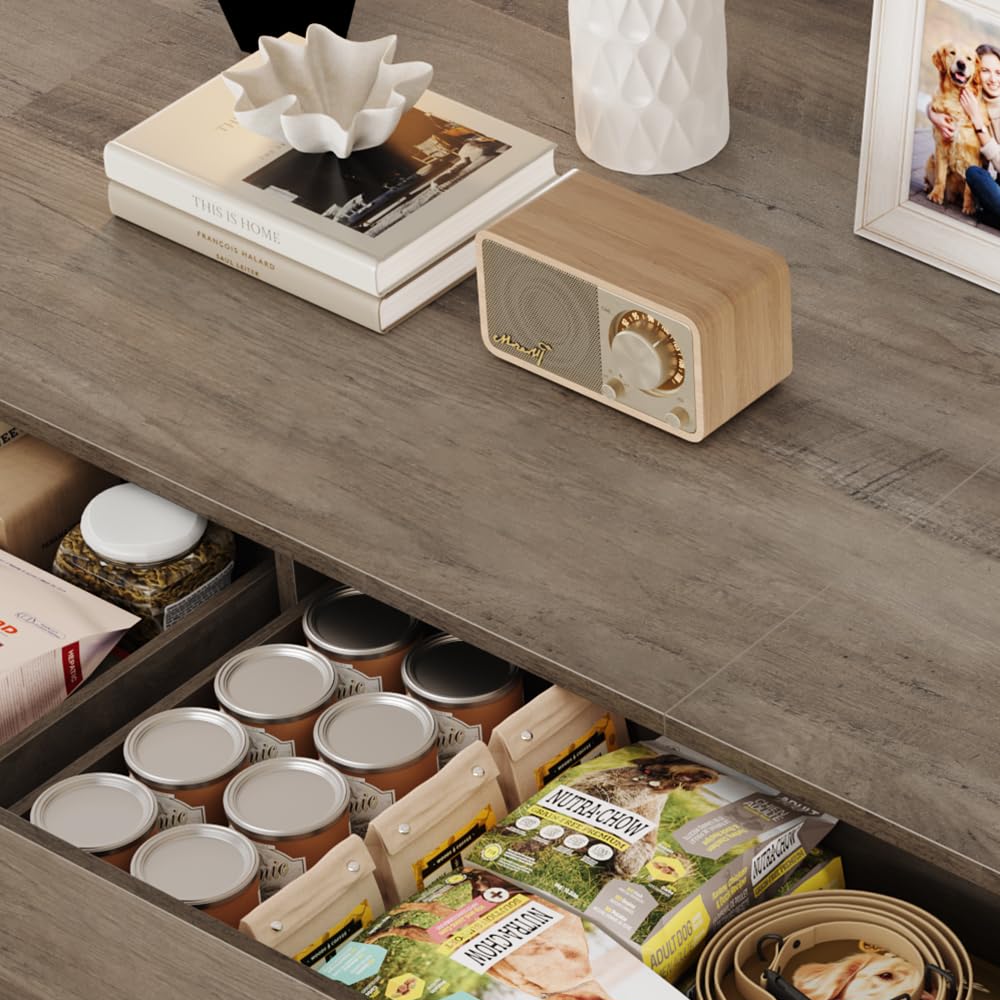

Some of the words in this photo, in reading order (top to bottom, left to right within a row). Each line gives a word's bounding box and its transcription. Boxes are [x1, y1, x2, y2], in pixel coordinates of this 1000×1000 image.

[192, 195, 223, 217] THIS
[226, 208, 237, 225] IS
[241, 216, 281, 245] HOME
[216, 253, 233, 266] SAUL
[235, 263, 259, 276] LEITER
[241, 252, 275, 270] HALARD
[650, 935, 677, 969] ADULT
[676, 921, 693, 947] DOG
